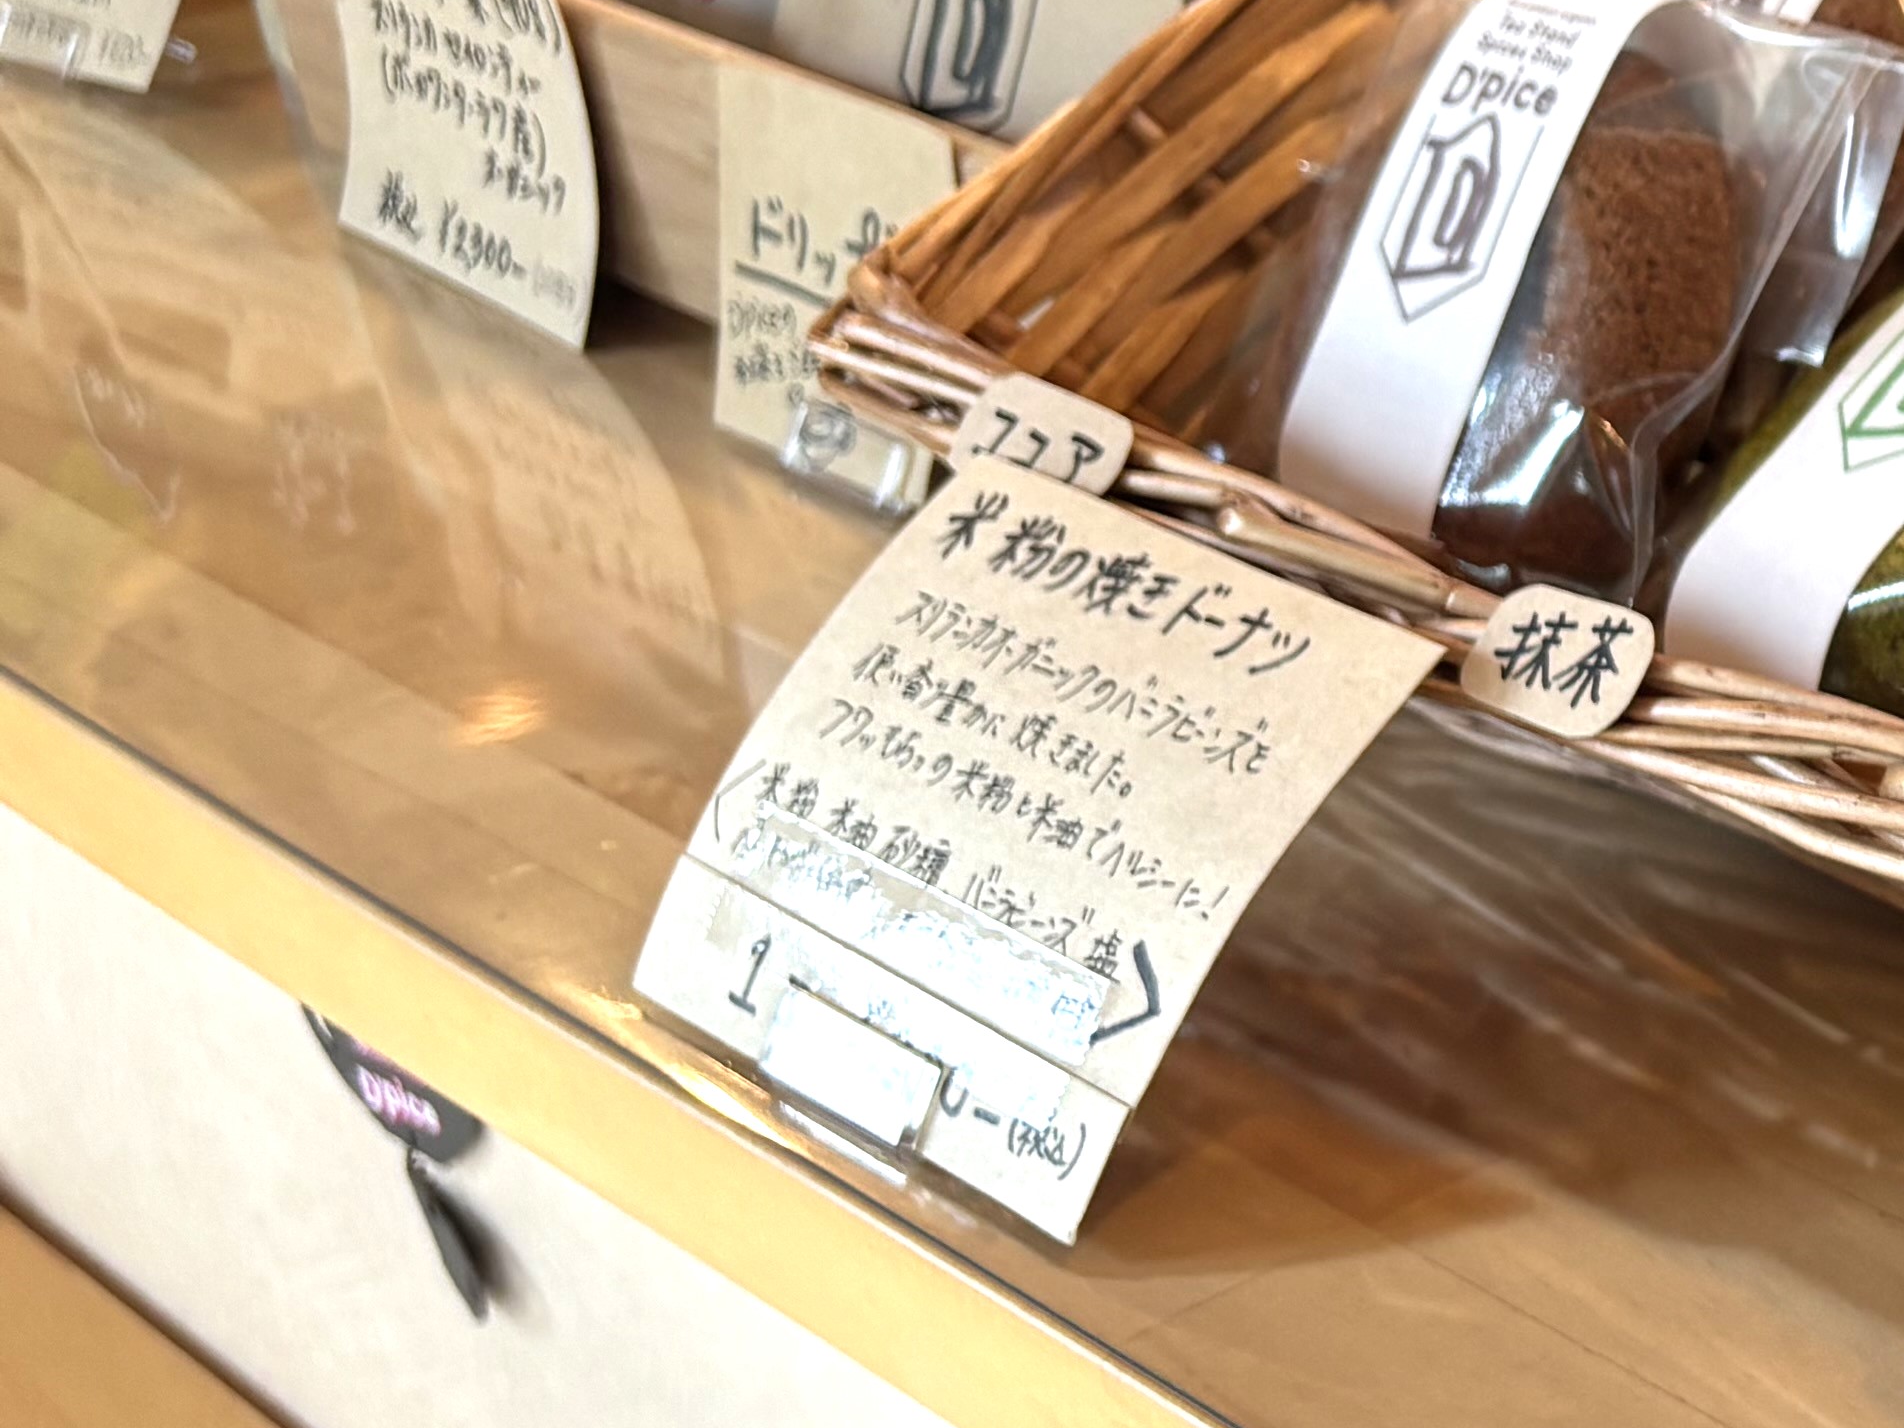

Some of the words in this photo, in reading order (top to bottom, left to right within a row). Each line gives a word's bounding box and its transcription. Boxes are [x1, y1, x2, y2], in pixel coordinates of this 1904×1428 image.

[1441, 61, 1559, 118] D'pice
[936, 492, 1311, 679] 米粉の焼きドーナツ
[1495, 609, 1635, 710] 抹茶
